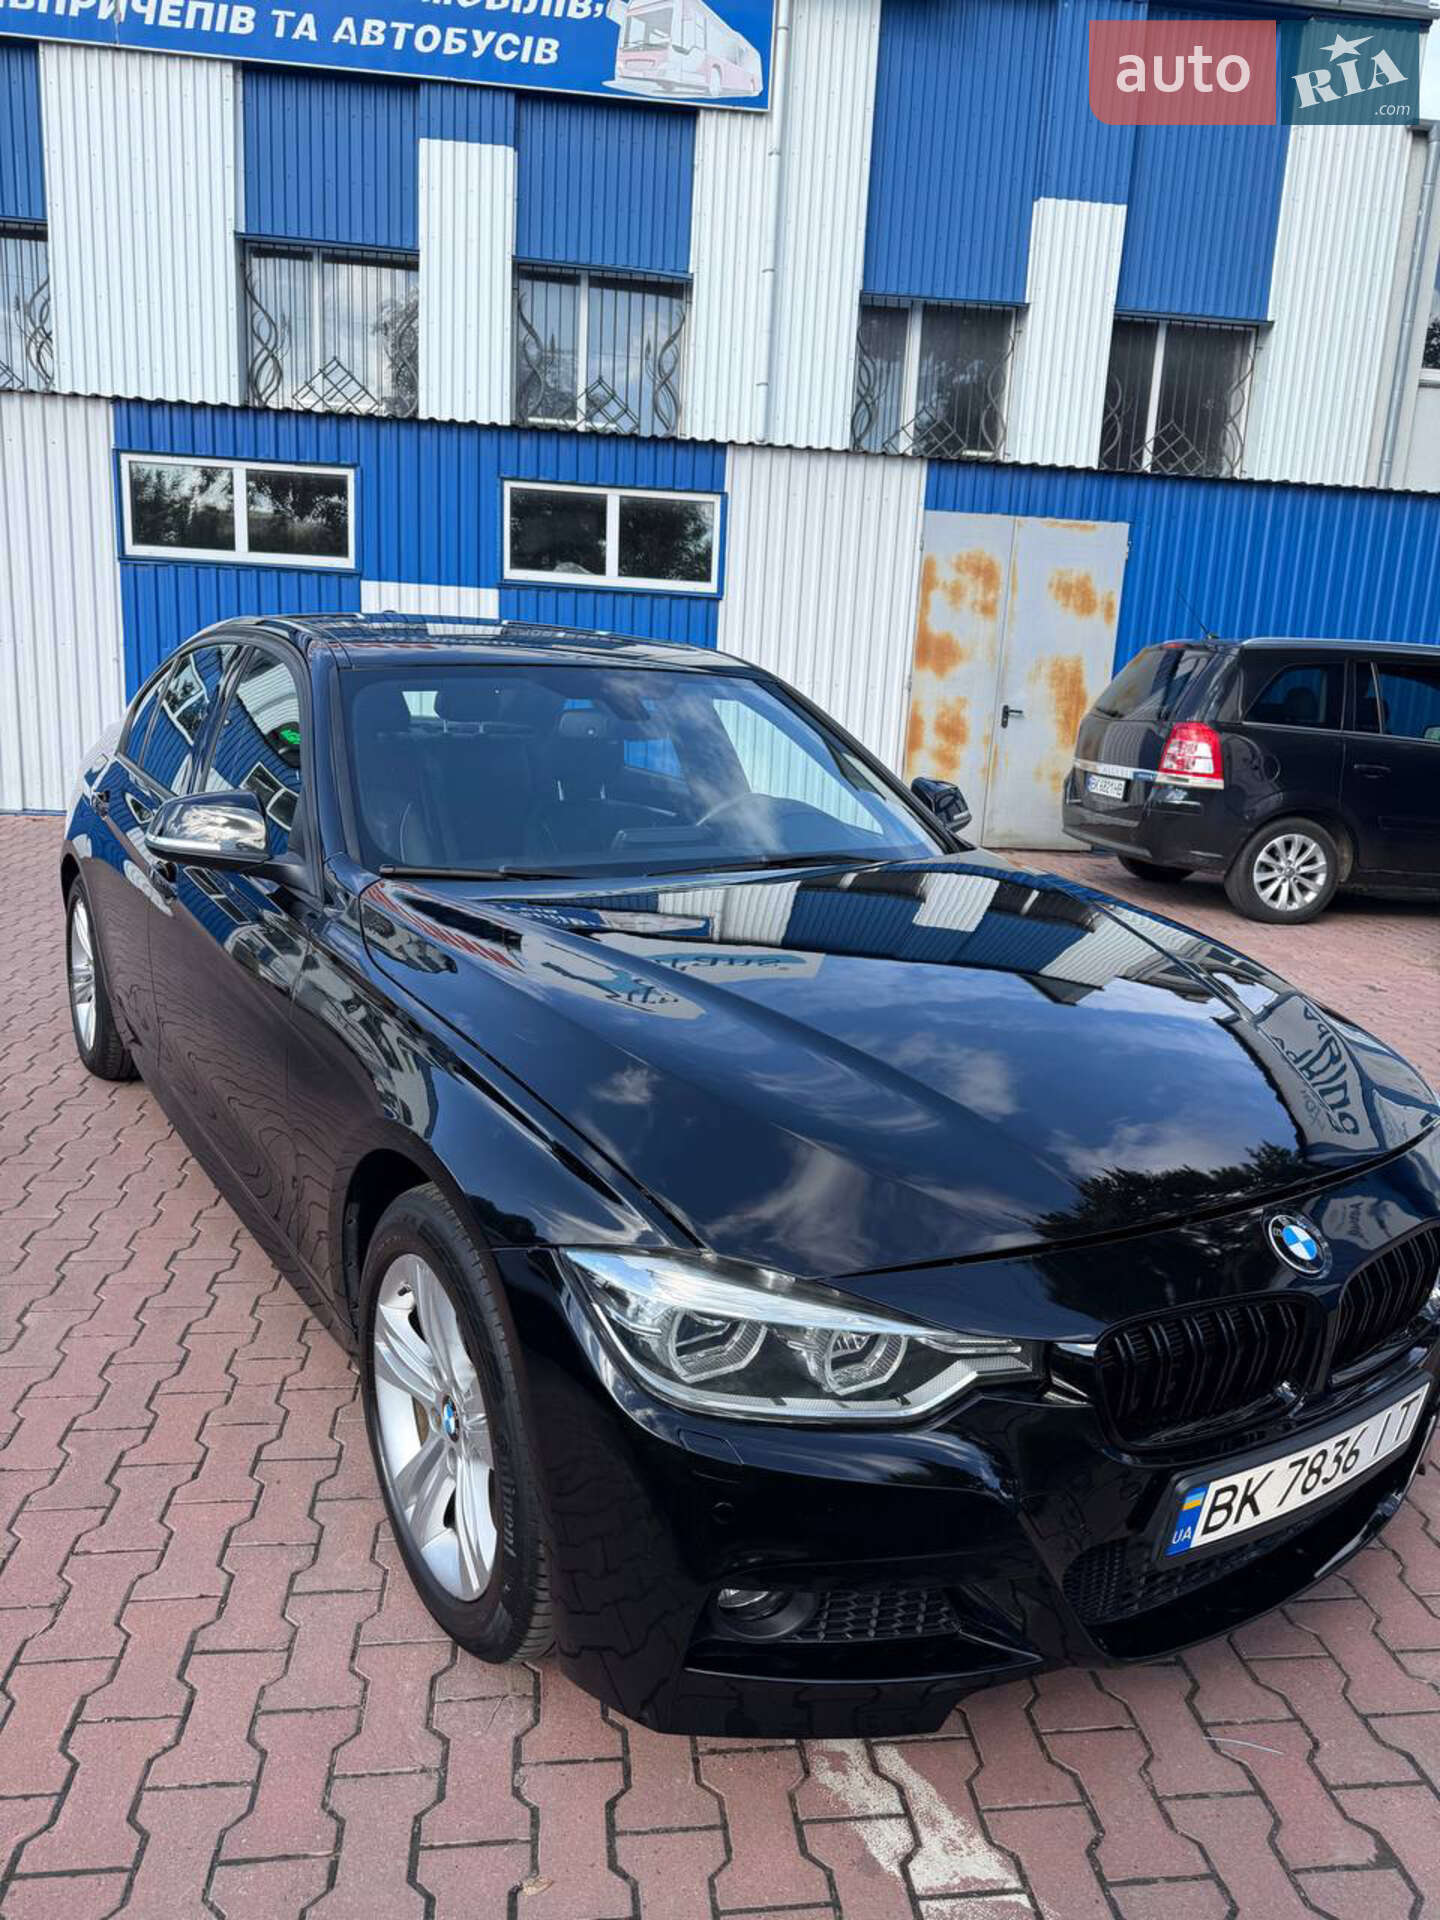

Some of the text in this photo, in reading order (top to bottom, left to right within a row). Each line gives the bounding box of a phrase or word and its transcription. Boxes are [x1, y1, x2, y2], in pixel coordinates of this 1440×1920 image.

[271, 10, 317, 41] ТА
[332, 17, 560, 65] АВТОБУСІВ
[1201, 1470, 1273, 1536] BK
[1277, 1426, 1368, 1508] 7836
[1172, 1525, 1192, 1544] UA
